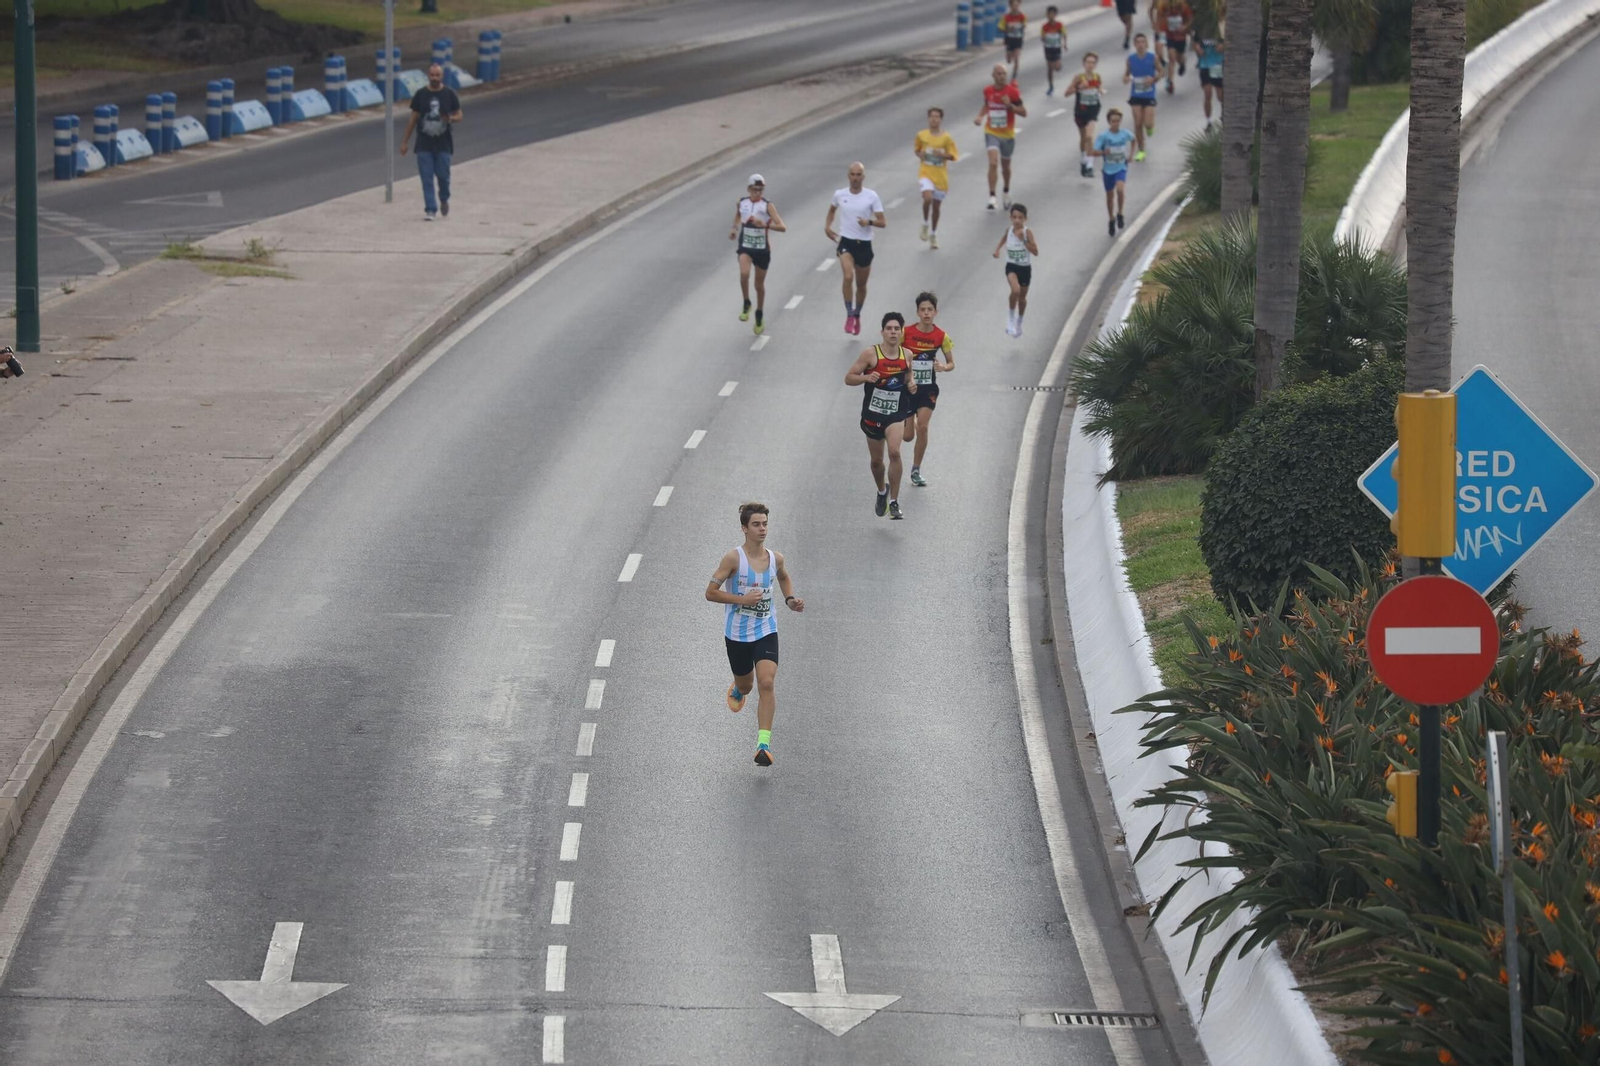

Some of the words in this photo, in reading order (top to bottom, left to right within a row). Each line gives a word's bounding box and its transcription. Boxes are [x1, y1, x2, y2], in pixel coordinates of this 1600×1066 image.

[913, 371, 930, 379] 0118
[872, 398, 897, 410] 23175
[1458, 484, 1548, 514] SICA
